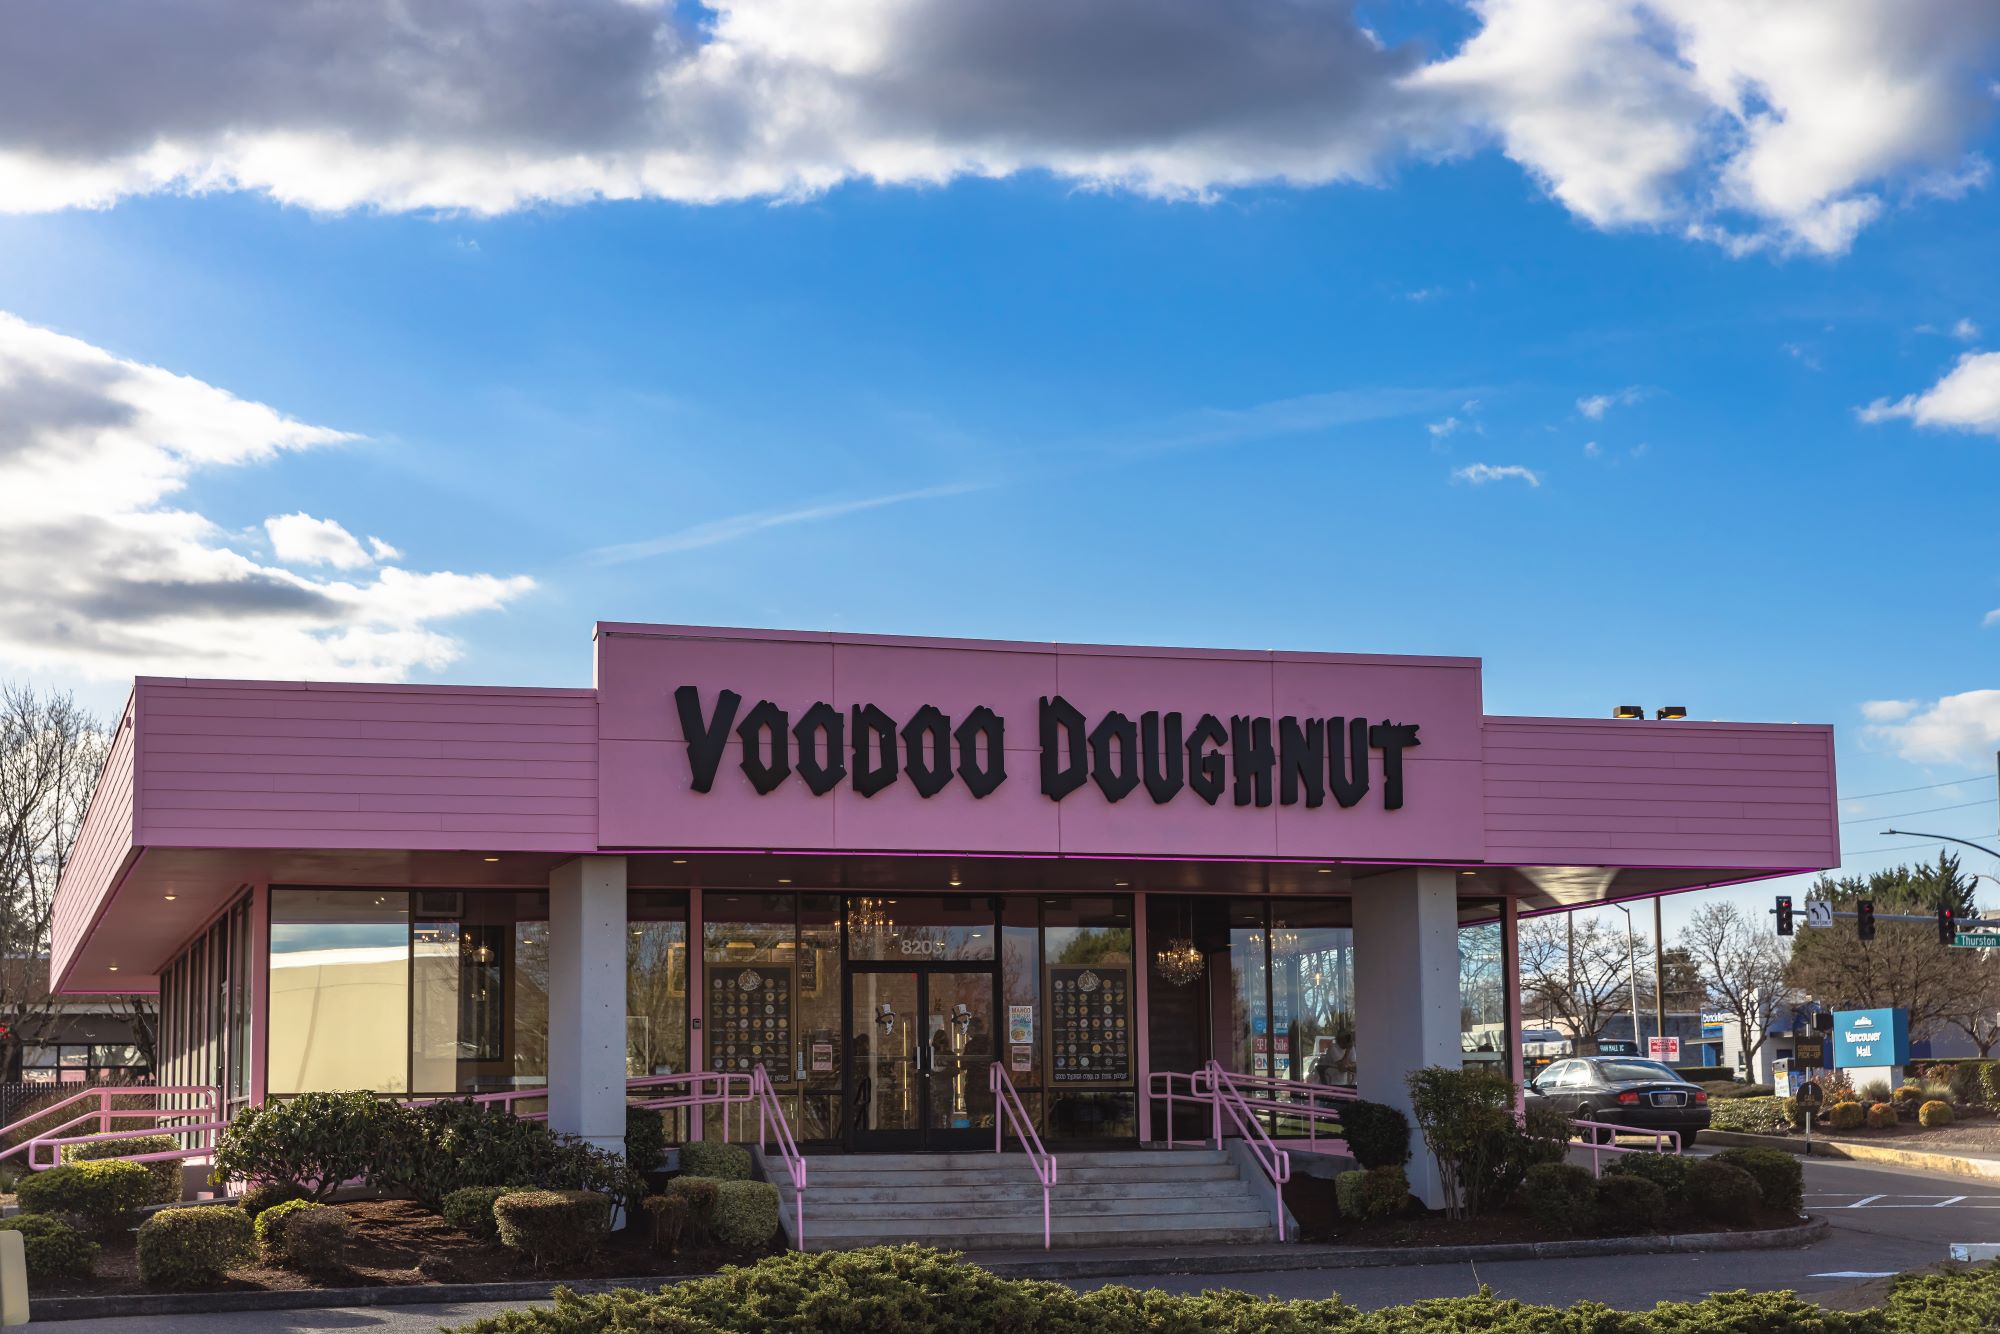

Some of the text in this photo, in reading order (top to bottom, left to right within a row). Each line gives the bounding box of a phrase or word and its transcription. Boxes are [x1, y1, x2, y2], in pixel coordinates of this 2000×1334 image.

[674, 685, 1421, 810] VOODOO DOUGHNUT
[1961, 935, 1997, 946] Thurston
[1845, 1031, 1881, 1043] Vancouver
[1856, 1045, 1872, 1057] Mall
